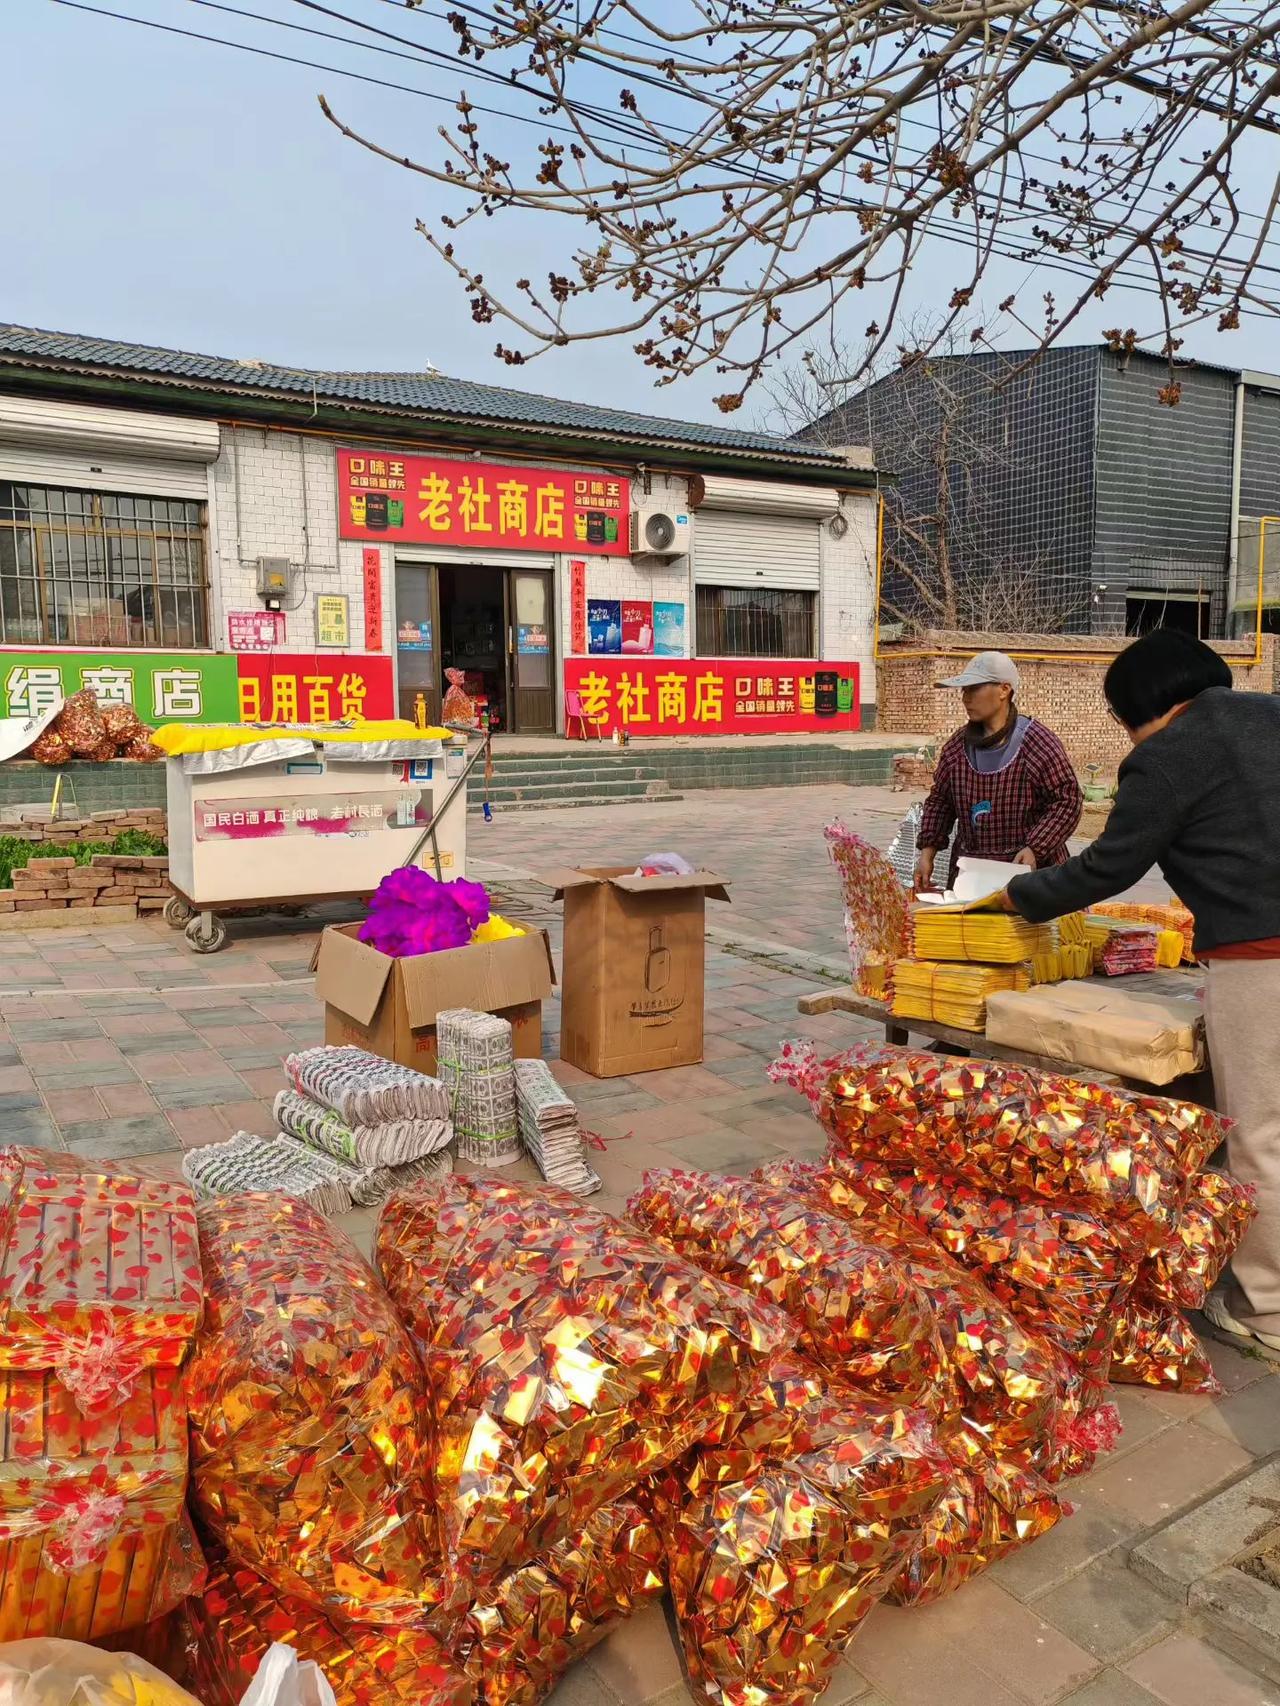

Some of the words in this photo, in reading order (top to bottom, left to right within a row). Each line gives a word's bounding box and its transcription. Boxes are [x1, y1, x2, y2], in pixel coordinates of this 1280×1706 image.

[350, 458, 404, 477] 口味王
[350, 475, 406, 490] 全国销量领先
[574, 480, 620, 497] 口味王
[418, 471, 565, 539] 老社商店
[735, 677, 795, 697] 口味王
[239, 673, 367, 723] 日用百货
[578, 671, 724, 724] 老社商店
[735, 699, 795, 713] 全国销量领先
[203, 811, 260, 827] 国民白酒
